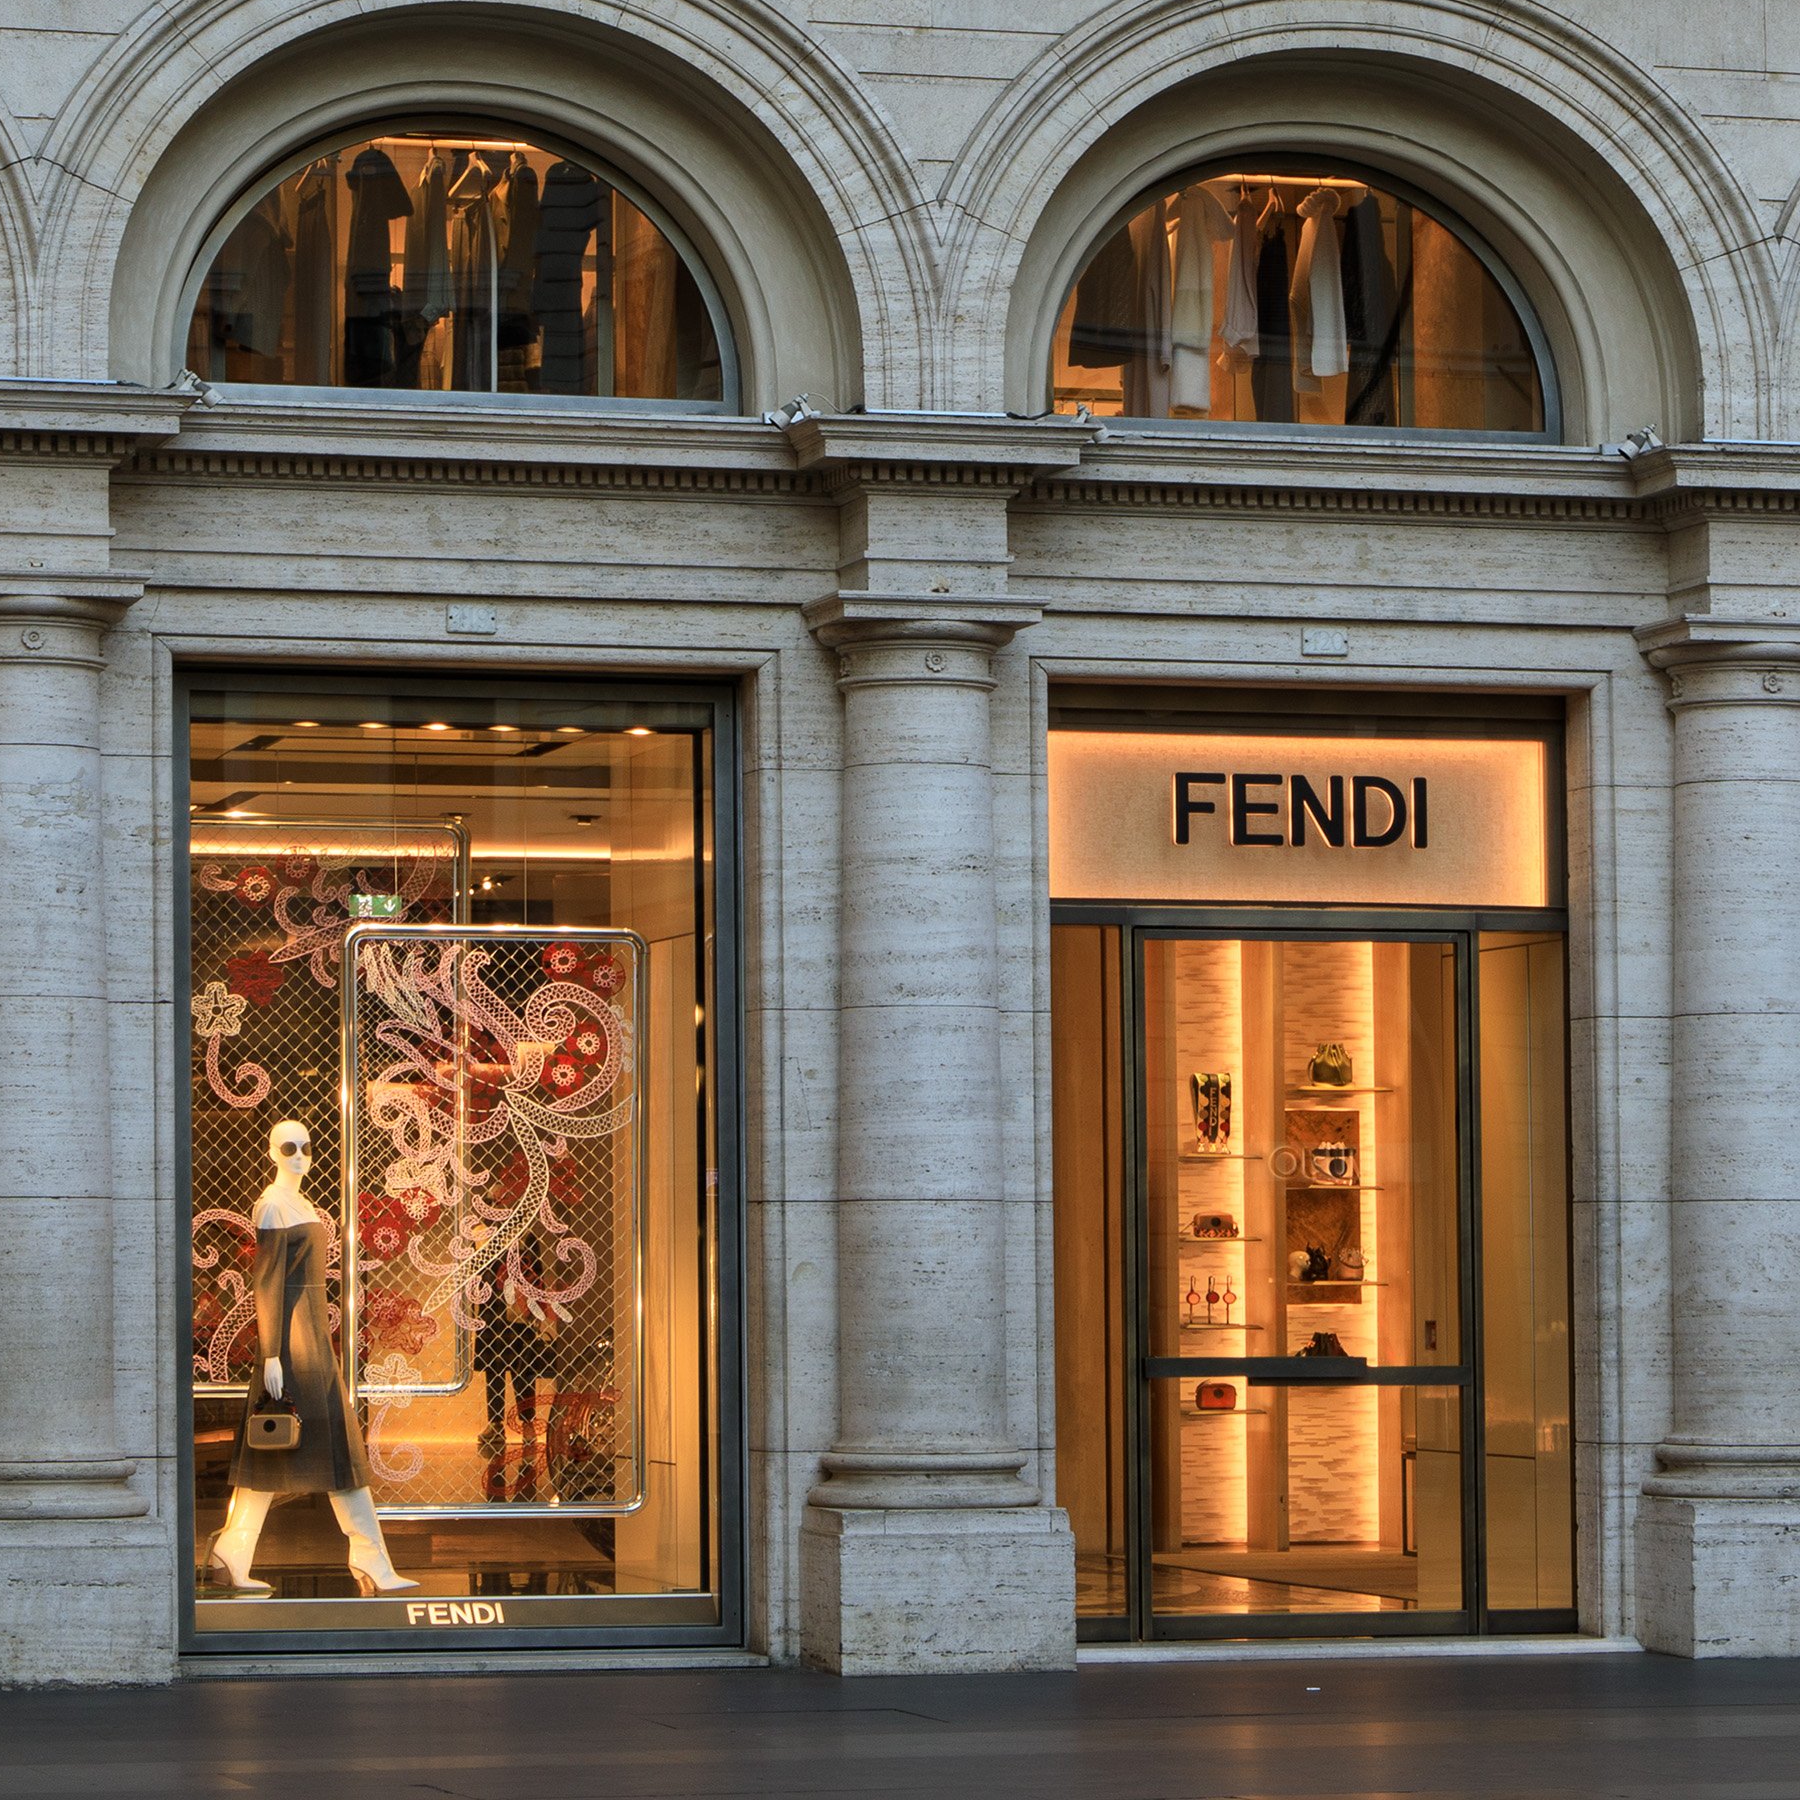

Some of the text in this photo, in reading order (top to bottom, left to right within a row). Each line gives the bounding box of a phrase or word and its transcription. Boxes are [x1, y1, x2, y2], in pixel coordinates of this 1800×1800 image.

[1171, 770, 1429, 850] FENDI
[1208, 1086, 1218, 1138] FENDI
[405, 1600, 506, 1626] FENDI
